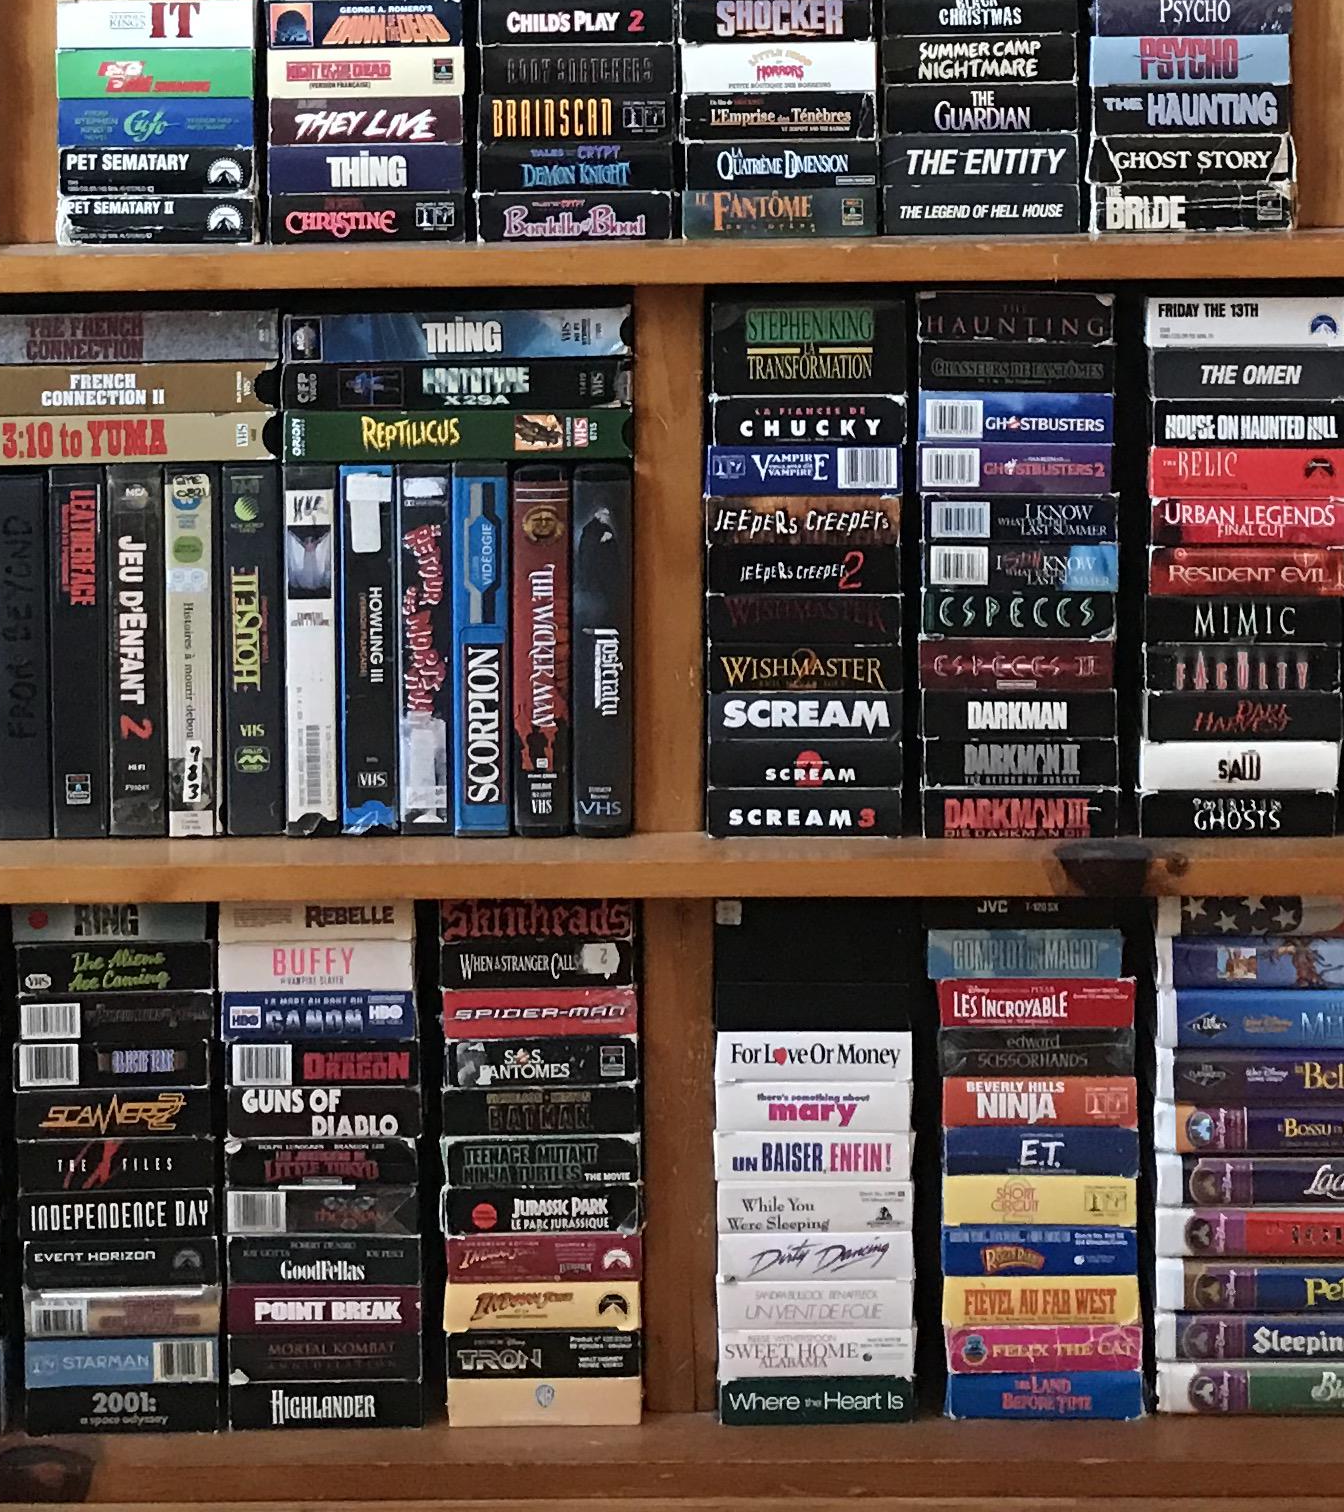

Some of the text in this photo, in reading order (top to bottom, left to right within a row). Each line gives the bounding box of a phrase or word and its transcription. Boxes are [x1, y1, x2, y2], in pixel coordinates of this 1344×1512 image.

[507, 13, 645, 33] CHILD'S PLAY 2
[67, 154, 189, 171] PET SEMATARY
[1158, 303, 1259, 318] FRIDAY THE 13TH
[70, 373, 136, 390] FRENCH
[41, 390, 165, 406] CONNECTION II
[2, 420, 167, 457] 3:10 to YUMA
[361, 416, 460, 449] REPTILICUS
[740, 417, 880, 437] CHUCKY
[467, 645, 501, 804] SCORPION
[723, 700, 890, 735] SCREAM
[968, 703, 1067, 730] DARKMAN
[273, 947, 353, 975] BUFFY
[242, 1089, 340, 1113] GUNS OF
[768, 1099, 858, 1127] mary
[312, 1114, 398, 1137] DIABLO
[254, 1300, 402, 1322] POINT BREAK
[729, 1393, 800, 1411] Where
[824, 1392, 884, 1411] Heart
[888, 1392, 903, 1409] Is
